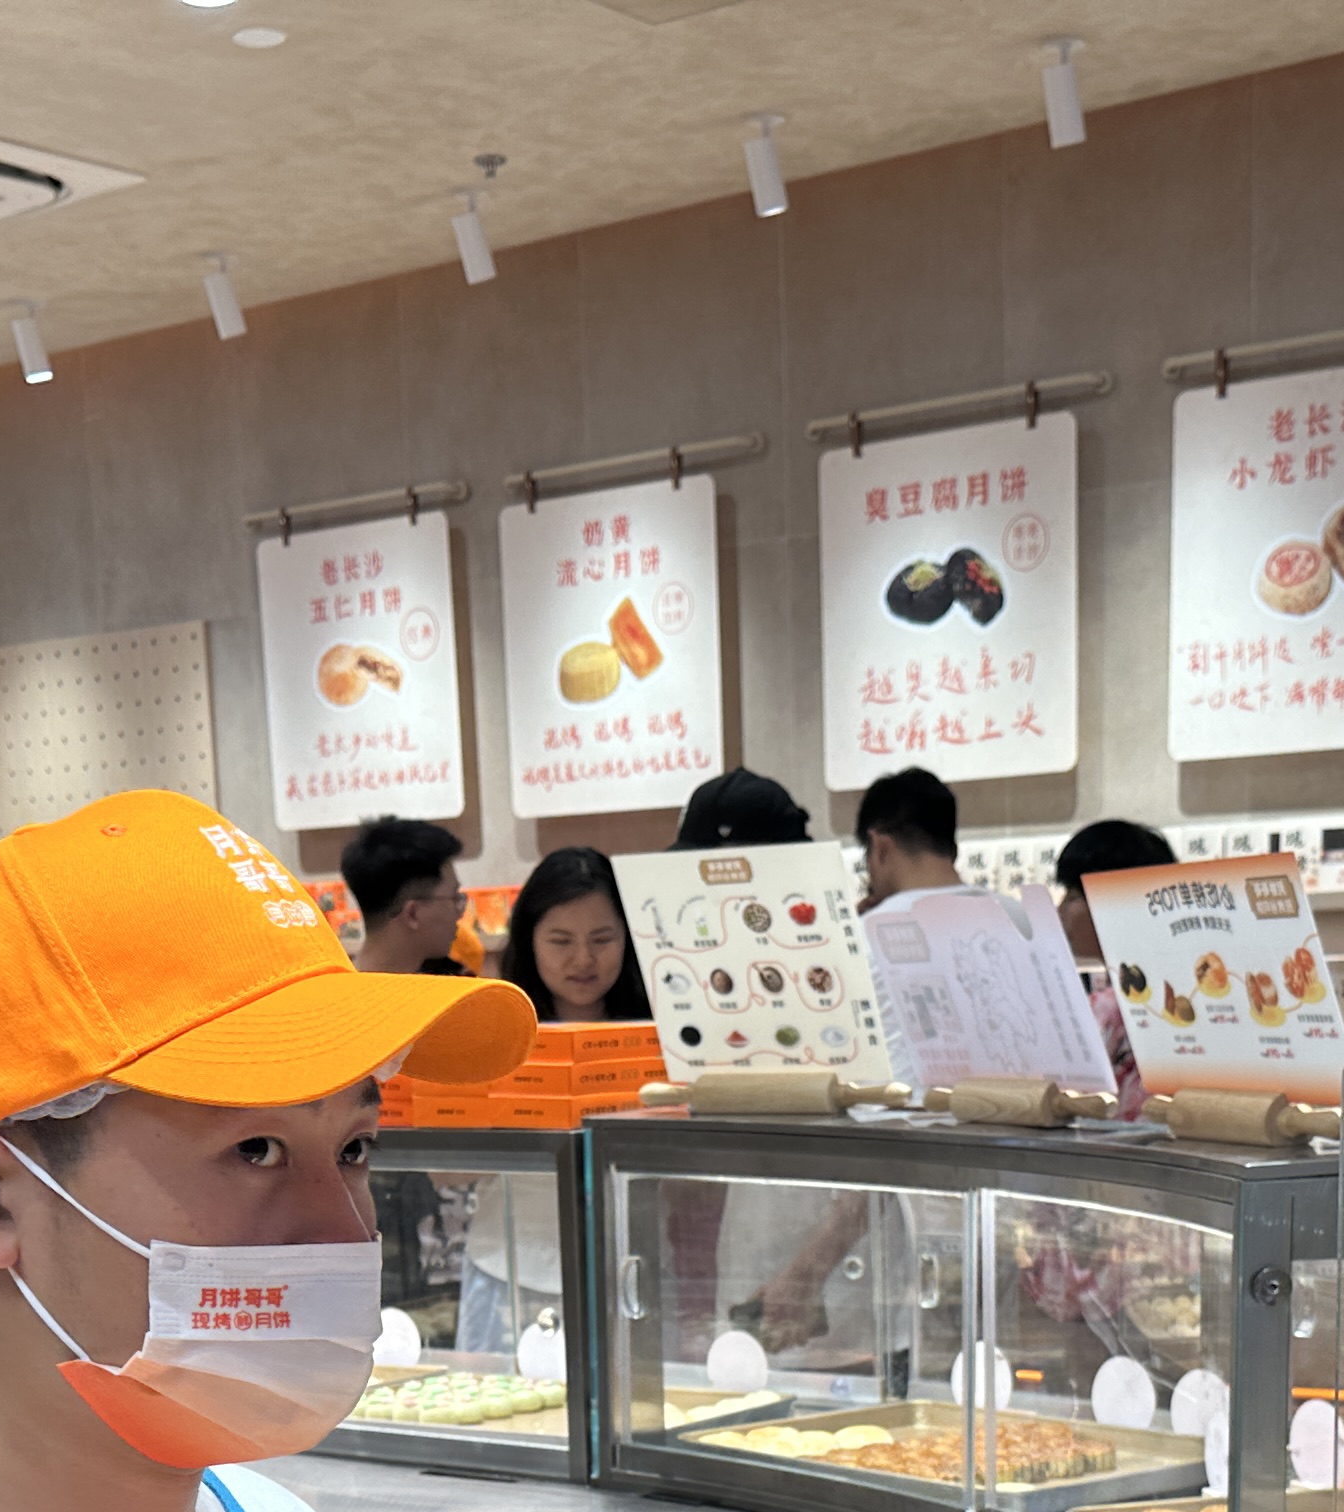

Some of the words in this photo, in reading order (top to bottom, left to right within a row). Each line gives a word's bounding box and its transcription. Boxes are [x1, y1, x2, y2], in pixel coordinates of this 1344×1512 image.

[864, 466, 1030, 524] 臭豆腐月饼
[581, 514, 633, 547] 奶黄
[319, 549, 385, 586] 老长沙
[556, 546, 662, 588] 流心月饼
[309, 586, 403, 625] 五仁月饼
[198, 1286, 284, 1309] 月饼哥哥
